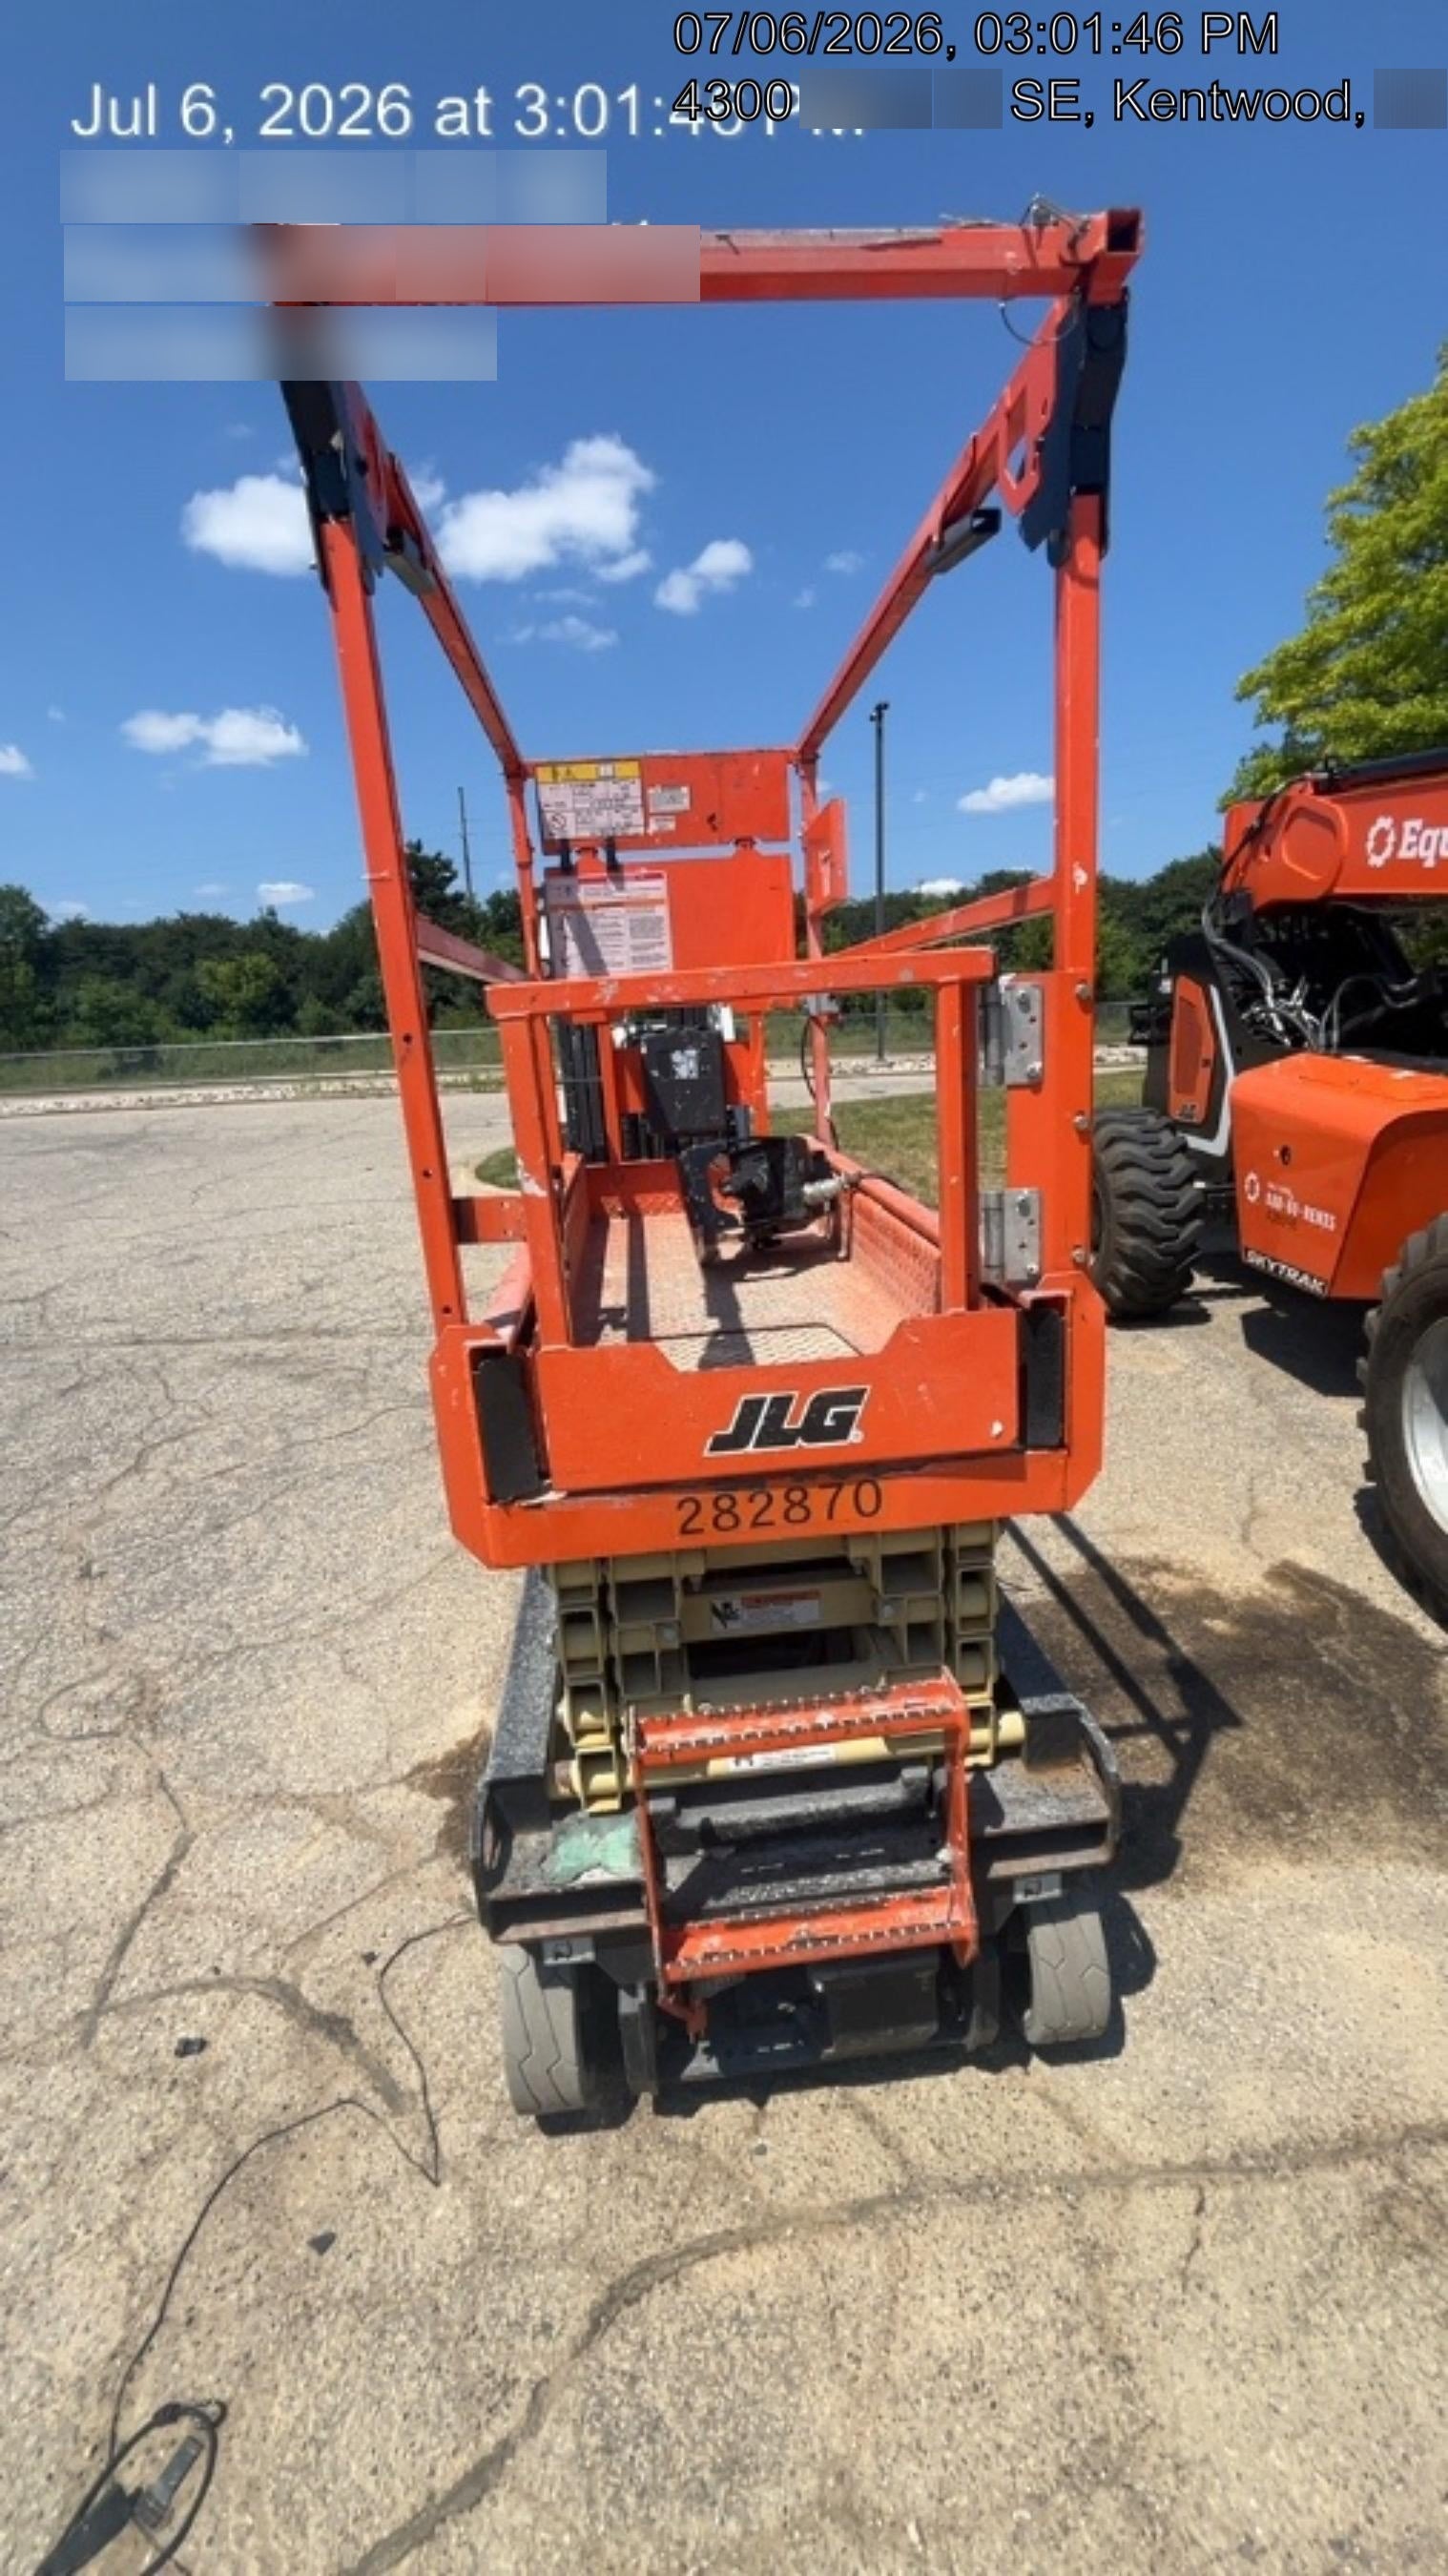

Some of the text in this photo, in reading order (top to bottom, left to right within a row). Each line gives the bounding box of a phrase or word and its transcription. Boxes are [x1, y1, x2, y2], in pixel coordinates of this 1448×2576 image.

[1246, 1249, 1327, 1297] SKYTRAK
[704, 1385, 870, 1457] JLG
[676, 1479, 883, 1536] 282870
